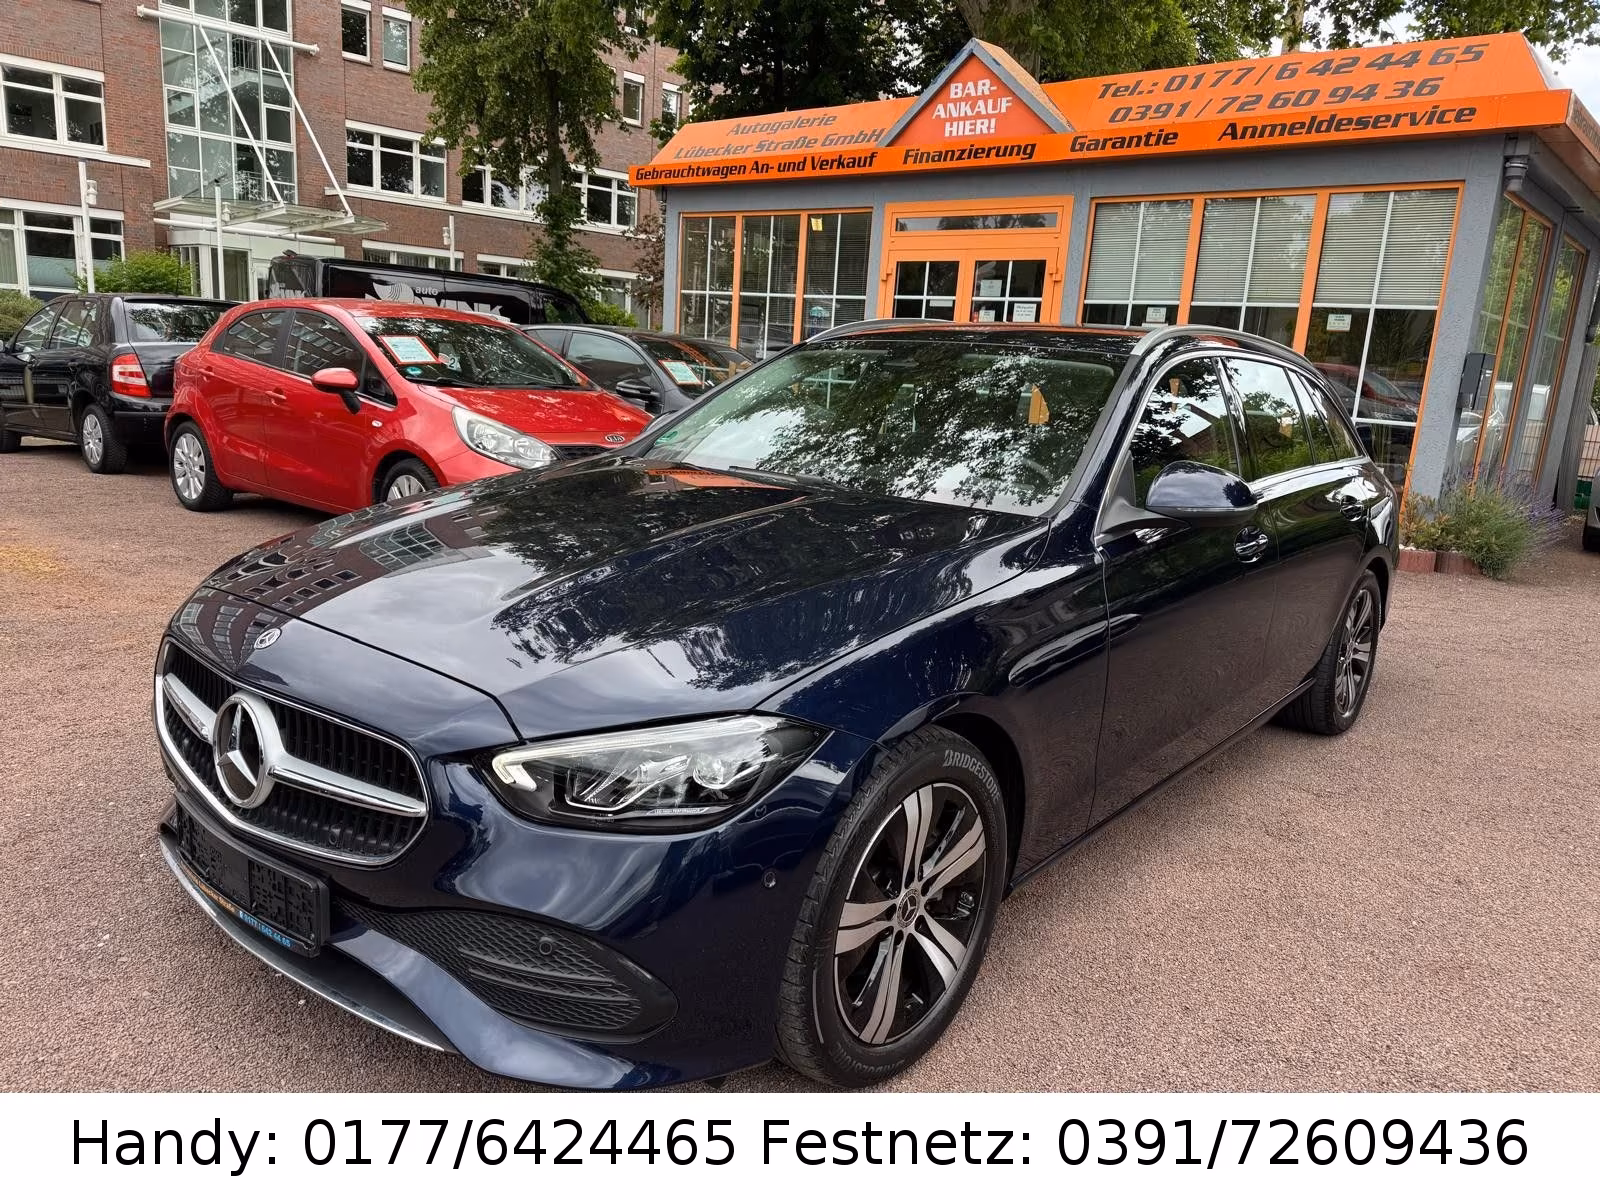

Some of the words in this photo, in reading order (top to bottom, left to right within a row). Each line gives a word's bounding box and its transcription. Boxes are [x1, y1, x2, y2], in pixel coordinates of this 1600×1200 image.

[1098, 80, 1159, 99] Tel.:
[1164, 66, 1256, 93] 0177
[1275, 61, 1303, 81] 6
[1306, 56, 1360, 77] 42
[1365, 50, 1422, 71] 44
[1428, 43, 1490, 66] 65
[950, 79, 998, 99] BAR-
[1108, 100, 1193, 124] 0391
[1217, 94, 1263, 114] 72
[1267, 89, 1320, 110] 60
[1324, 83, 1380, 105] 94
[1384, 76, 1445, 100] 36
[932, 96, 1013, 119] ANKAUF
[726, 113, 838, 136] Autogalerie
[944, 118, 997, 137] HIER!
[1217, 104, 1477, 142] Anmeldeservice
[674, 143, 753, 159] Lübecker
[753, 135, 819, 153] Straße
[821, 127, 886, 147] GmbH
[1069, 129, 1179, 153] Garantie
[635, 164, 747, 181] Gebrauchtwagen
[751, 160, 775, 175] An-
[777, 156, 808, 173] und
[811, 151, 879, 171] Verkauf
[902, 143, 1038, 165] Finanzierung
[415, 284, 439, 297] auto
[943, 749, 1001, 805] BRIDGESTONE
